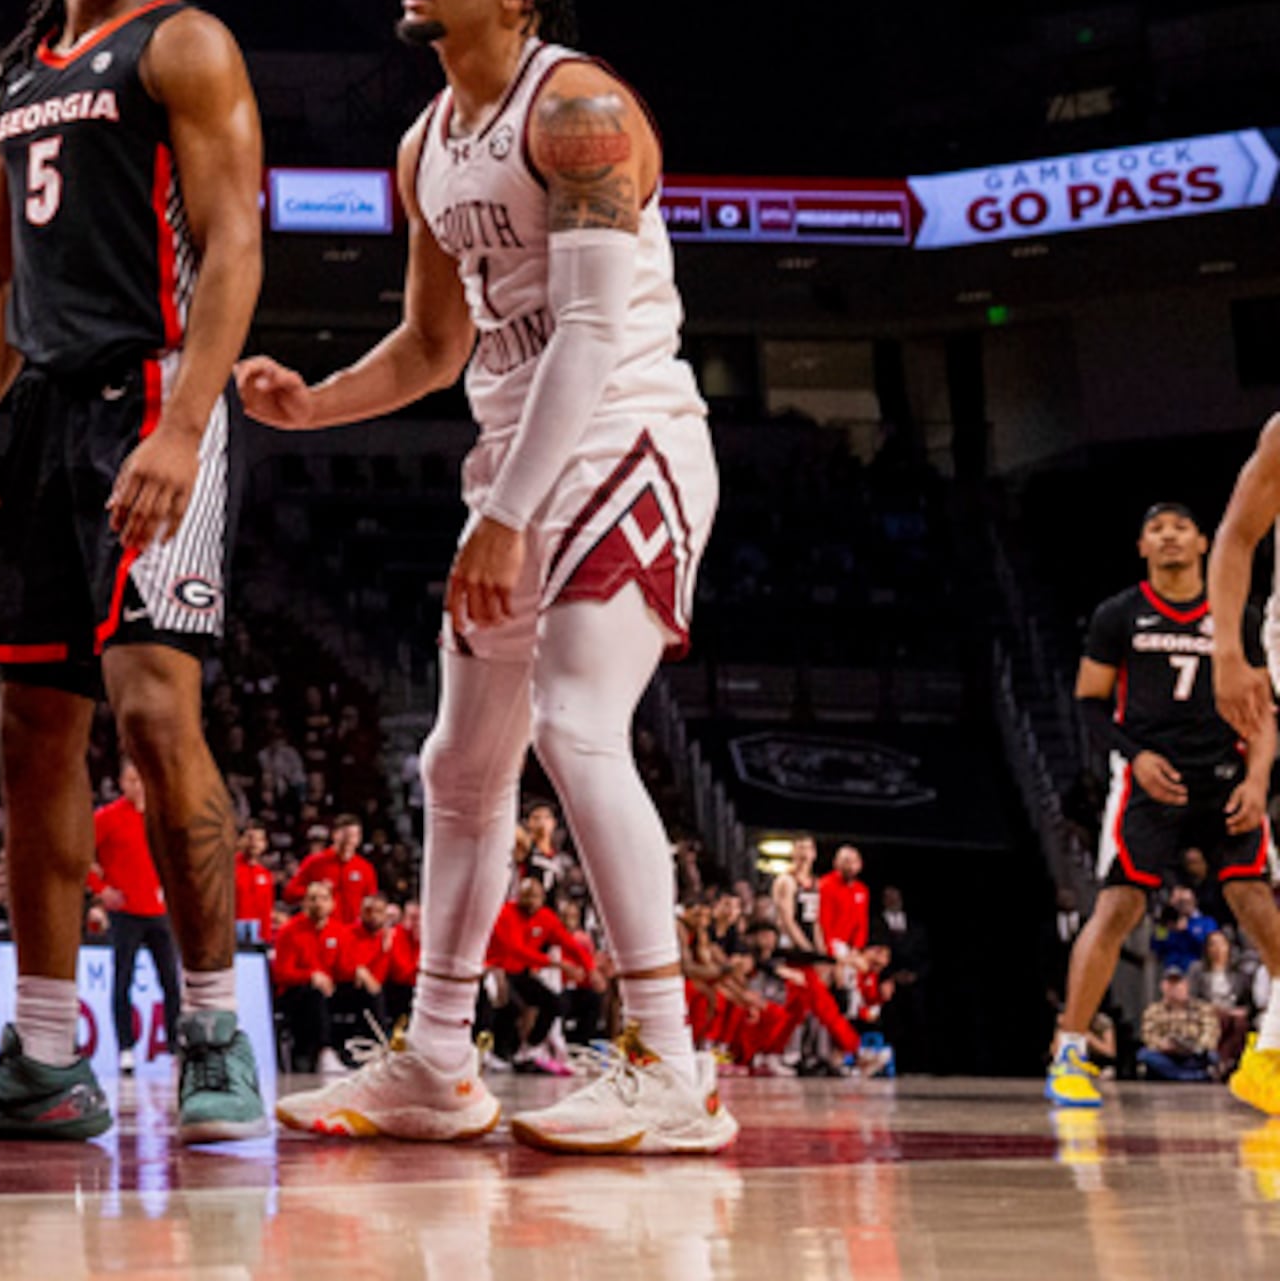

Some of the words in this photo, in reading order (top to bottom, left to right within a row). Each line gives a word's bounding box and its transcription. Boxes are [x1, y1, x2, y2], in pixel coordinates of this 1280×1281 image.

[25, 134, 64, 227] 5
[984, 144, 1193, 191] GAMECOCK
[965, 190, 1049, 233] GO
[1066, 165, 1224, 222] PASS
[1131, 631, 1217, 655] GEORG
[1168, 655, 1200, 701] 7
